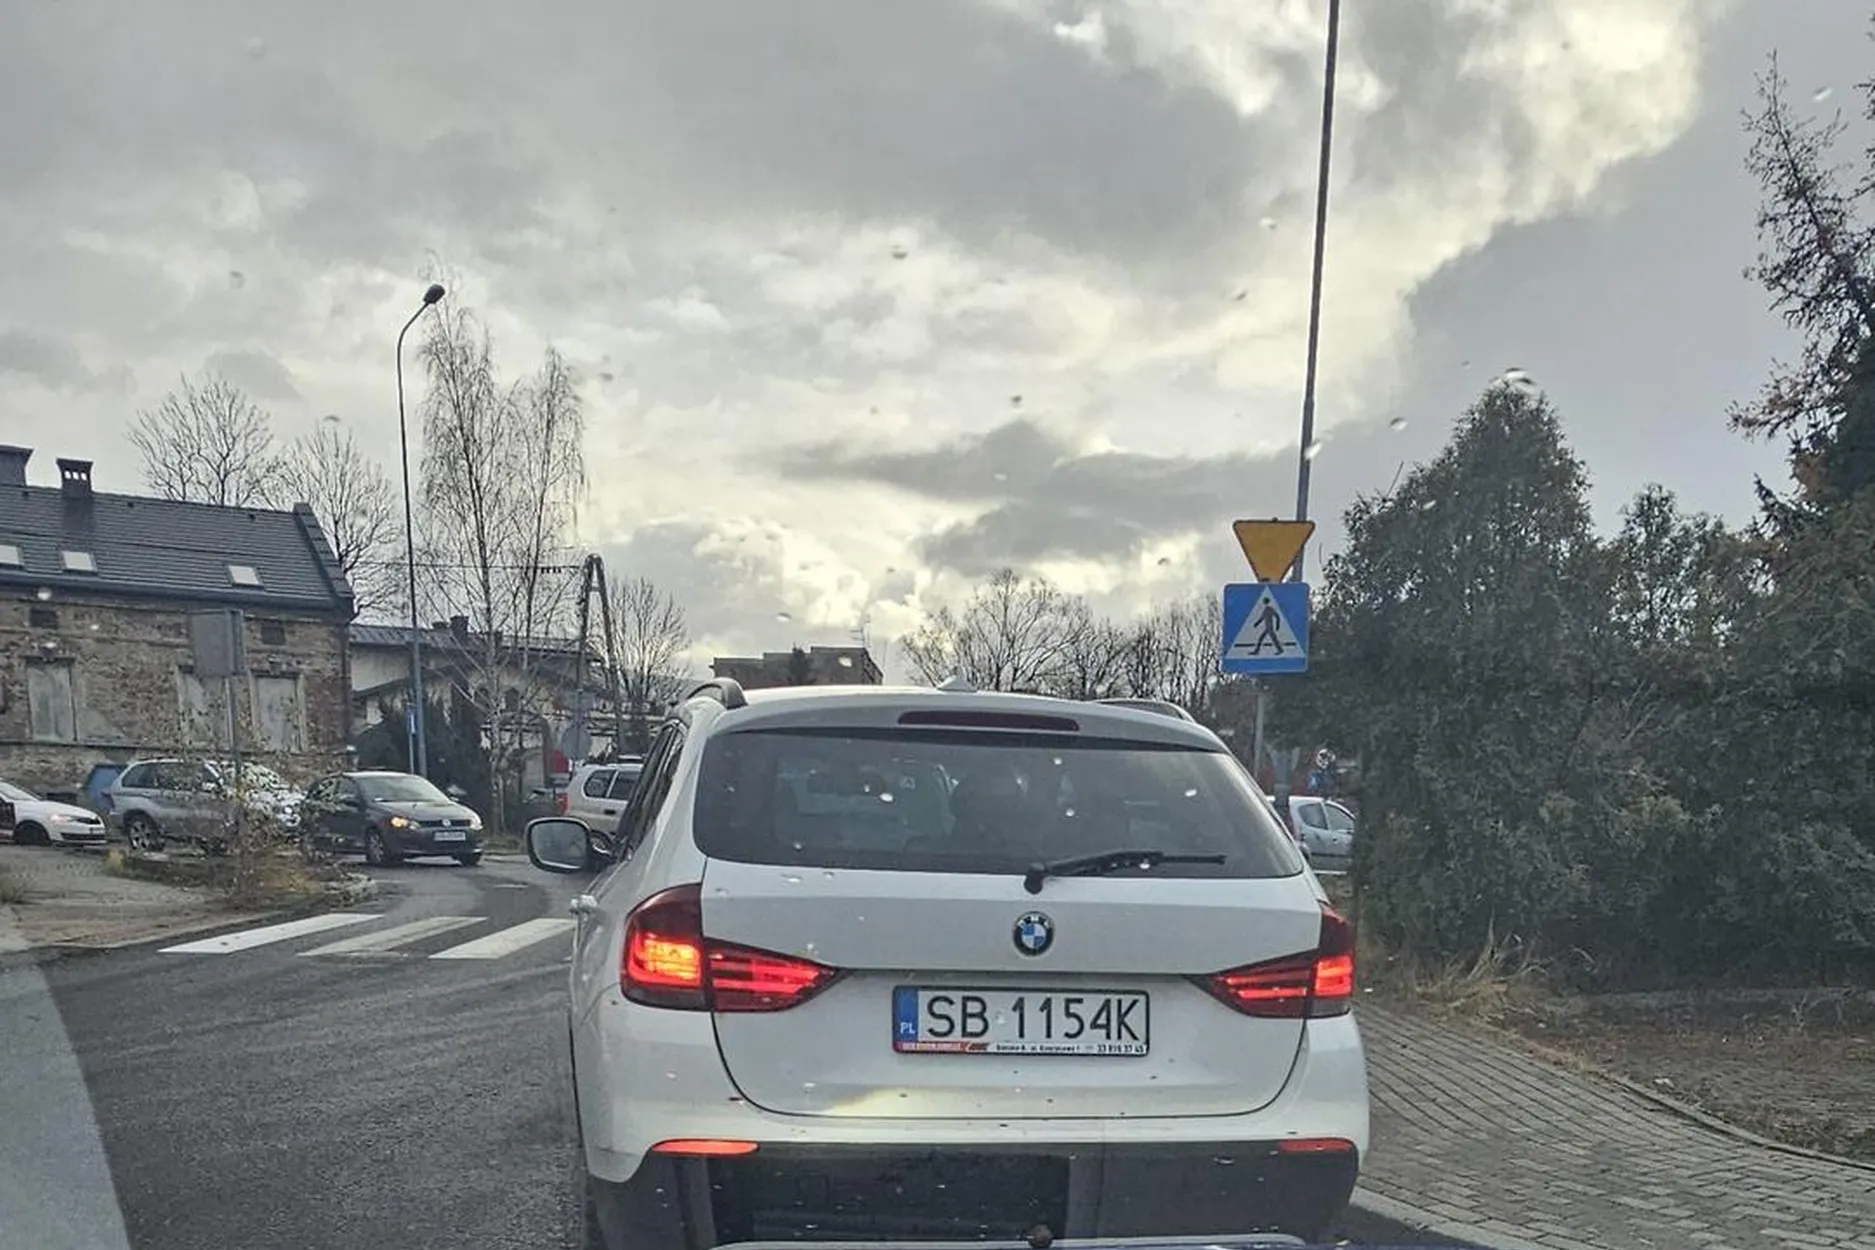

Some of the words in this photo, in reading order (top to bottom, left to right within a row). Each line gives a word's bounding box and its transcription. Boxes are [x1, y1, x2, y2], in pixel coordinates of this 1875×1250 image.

[899, 1022, 916, 1035] PL
[926, 995, 990, 1038] SB
[1011, 996, 1140, 1041] 1154K
